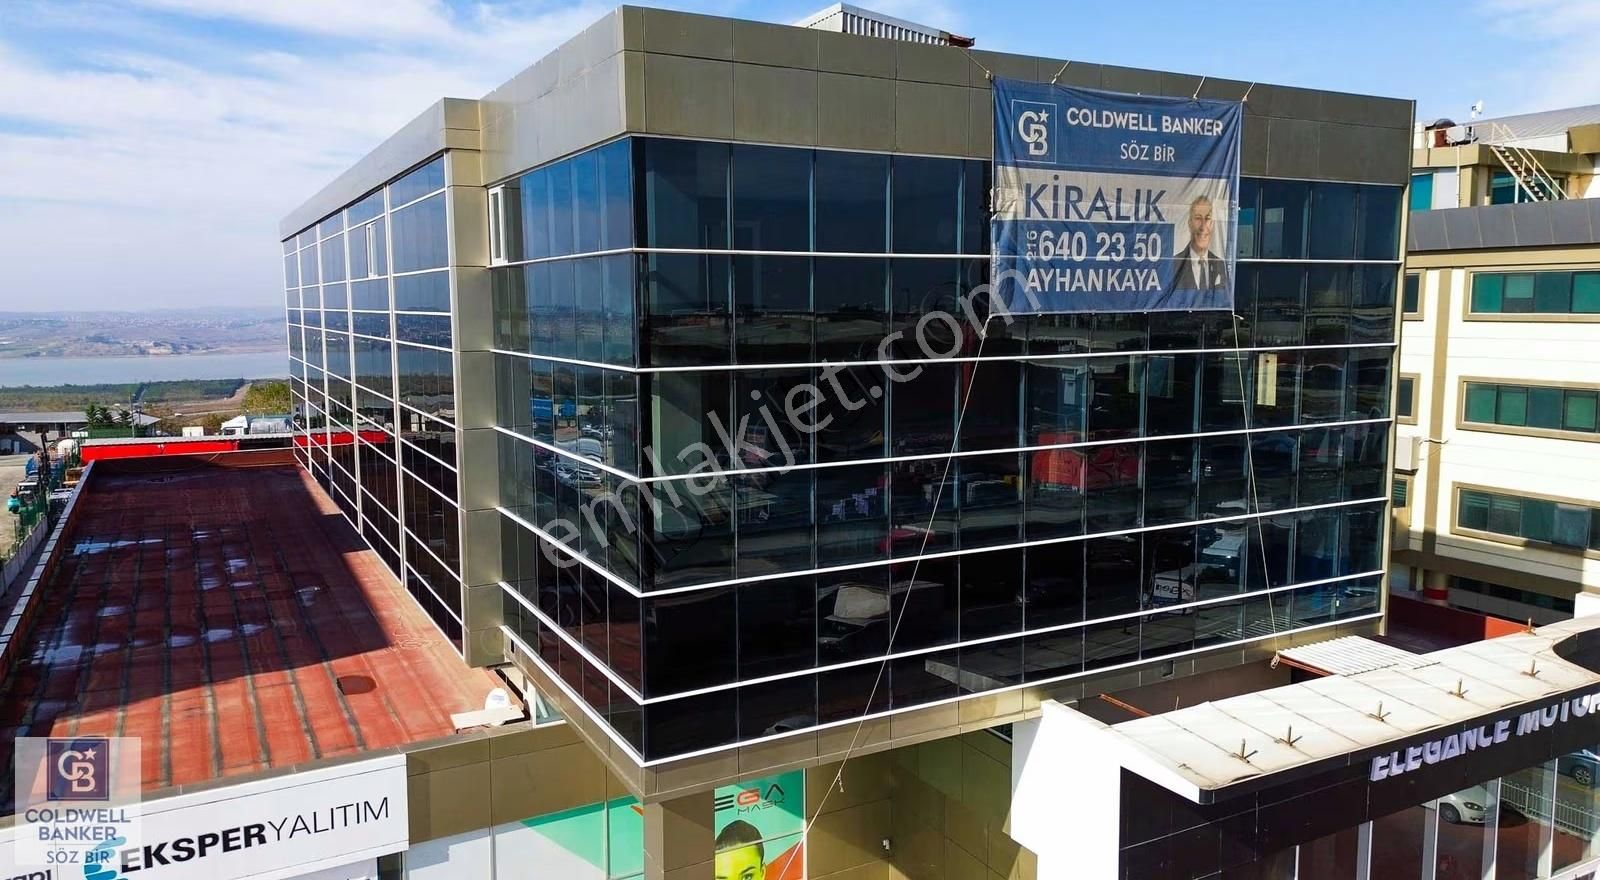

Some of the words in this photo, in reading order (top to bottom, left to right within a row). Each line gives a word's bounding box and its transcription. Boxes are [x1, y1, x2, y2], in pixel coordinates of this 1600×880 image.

[1066, 107, 1158, 132] COLDWELL
[1162, 115, 1223, 136] BANKER
[1120, 140, 1149, 161] SÖZ
[1025, 174, 1167, 222] KİRALIK
[1026, 230, 1038, 261] 216
[1039, 230, 1087, 262] 640
[1096, 232, 1126, 262] 23
[1133, 232, 1162, 262] 50
[1370, 719, 1511, 782] ELEGANCE
[714, 783, 785, 812] EGA
